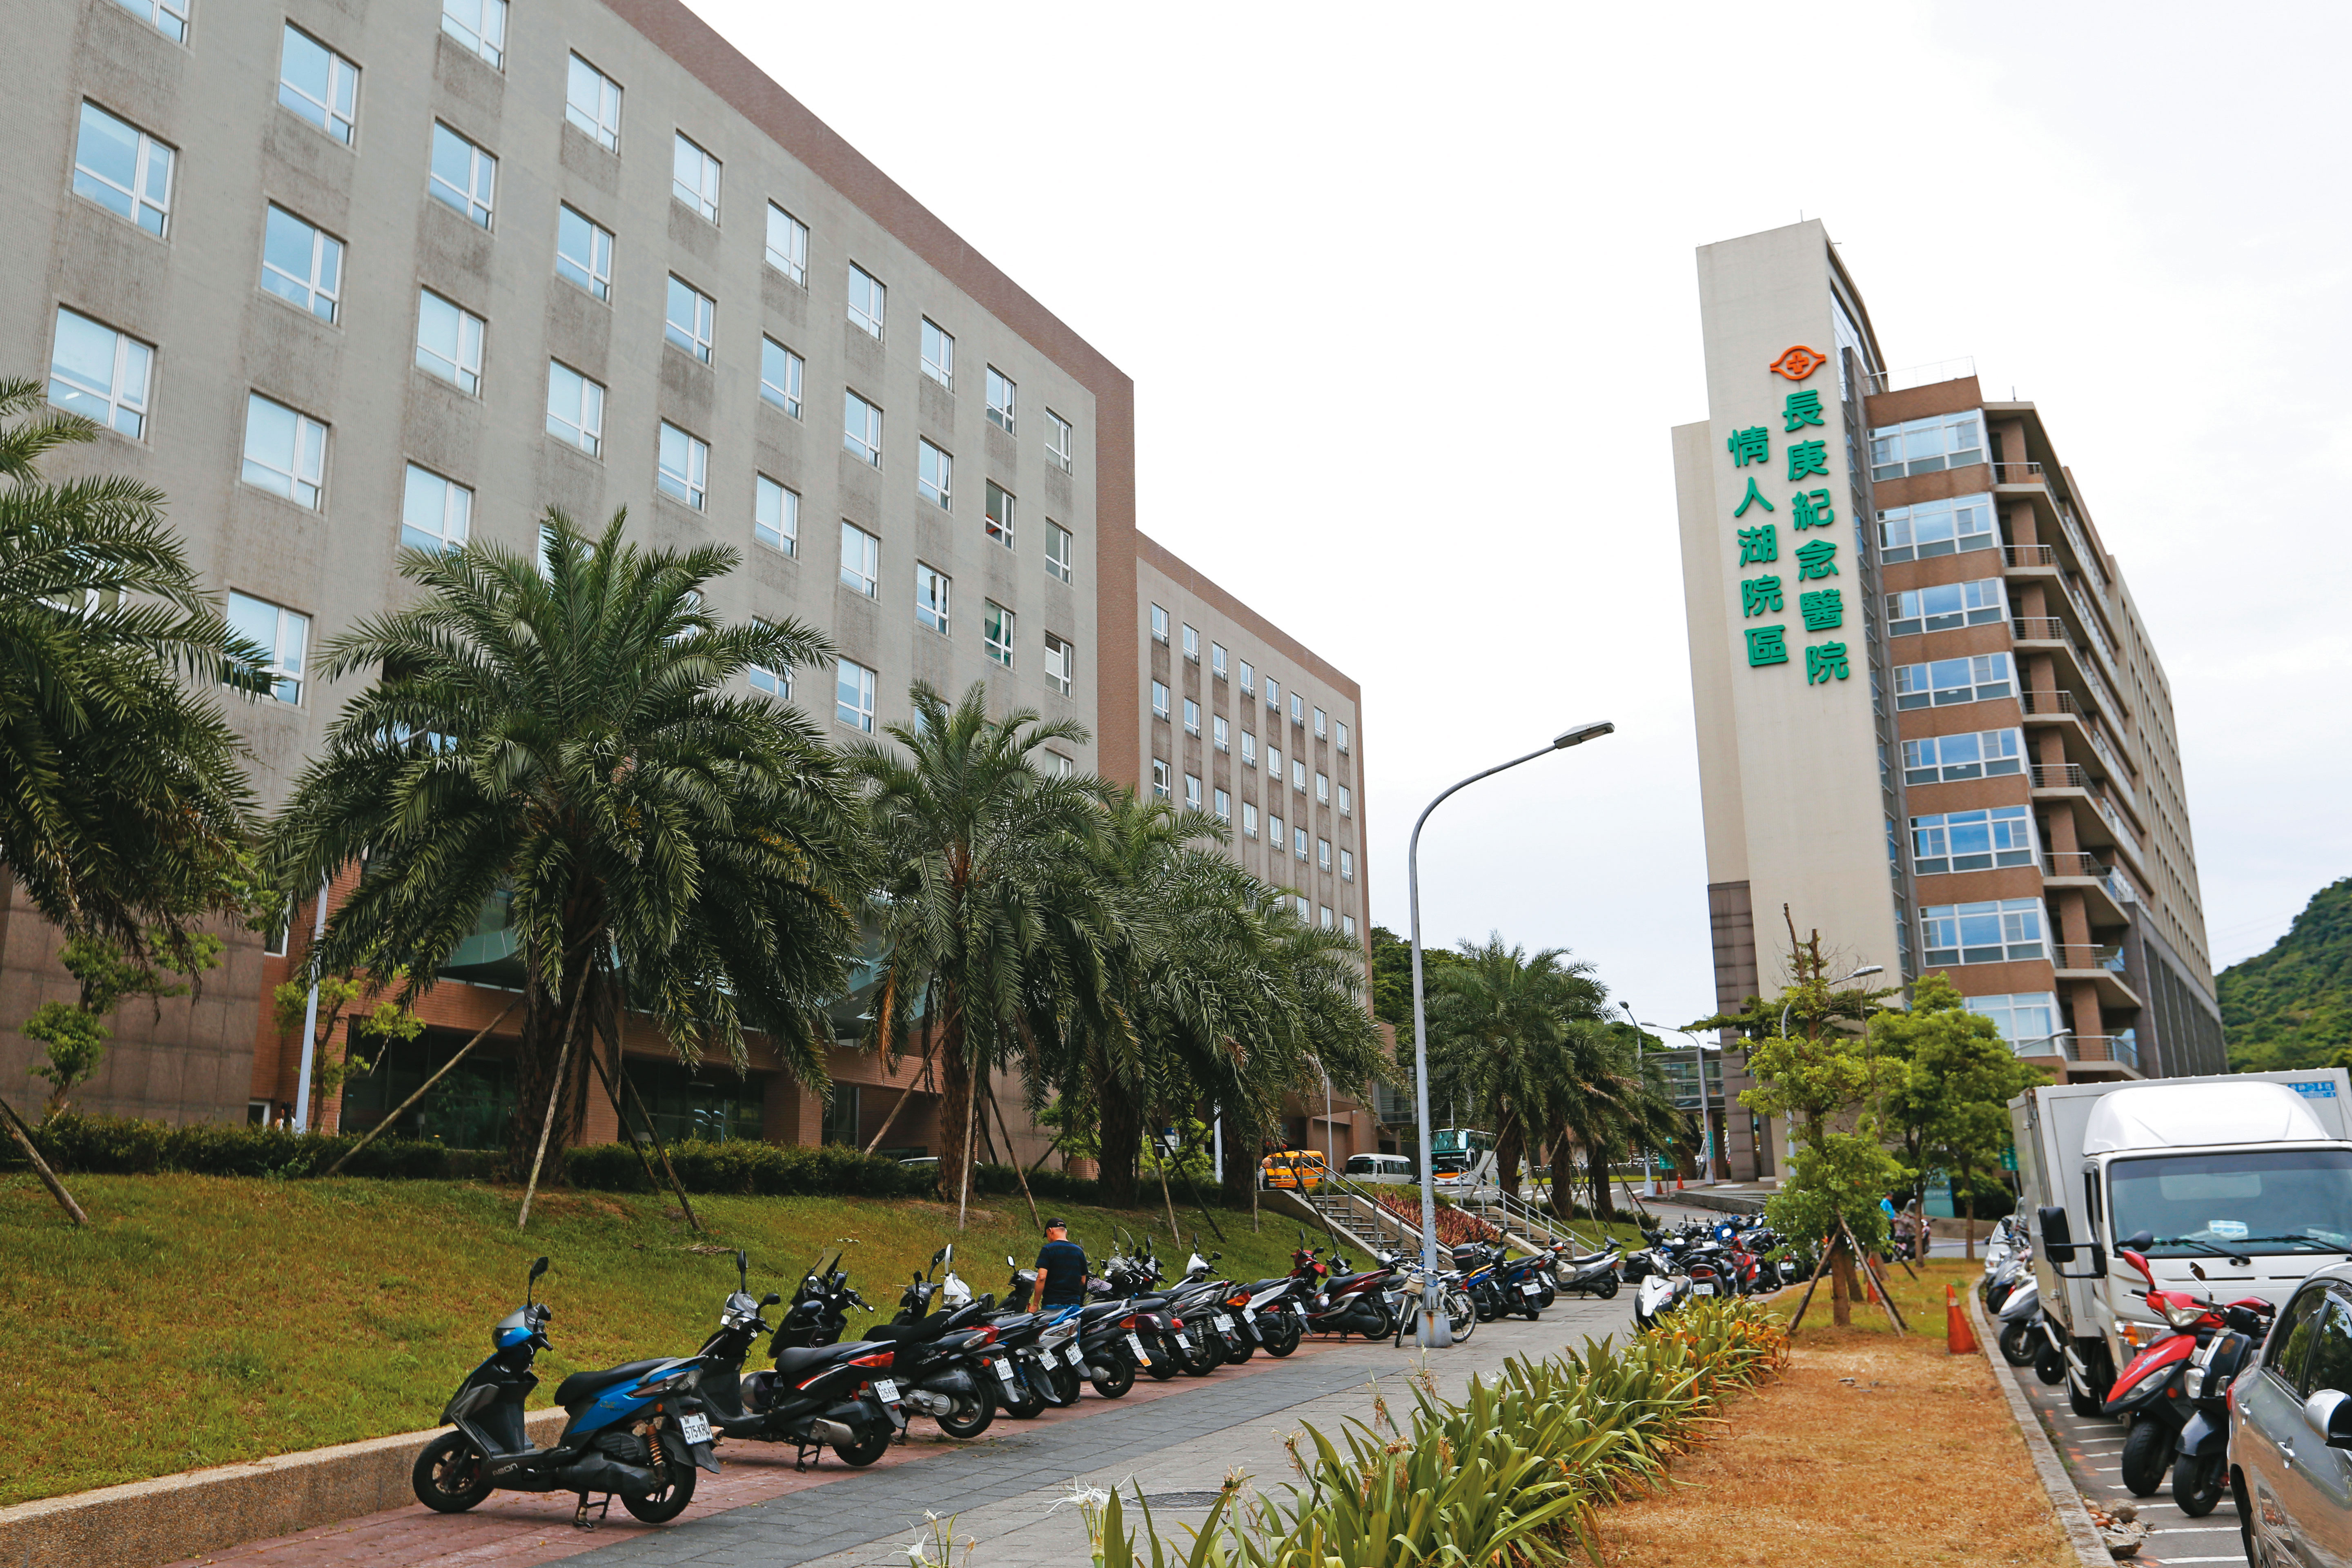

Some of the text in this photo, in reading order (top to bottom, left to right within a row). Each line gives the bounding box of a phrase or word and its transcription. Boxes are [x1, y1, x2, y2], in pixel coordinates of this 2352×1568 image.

[1728, 426, 1788, 666] 情人湖院區
[1782, 390, 1849, 684] 長庚紀念醫院
[684, 1423, 710, 1440] 575-KRU
[879, 1386, 899, 1399] 326-KRR
